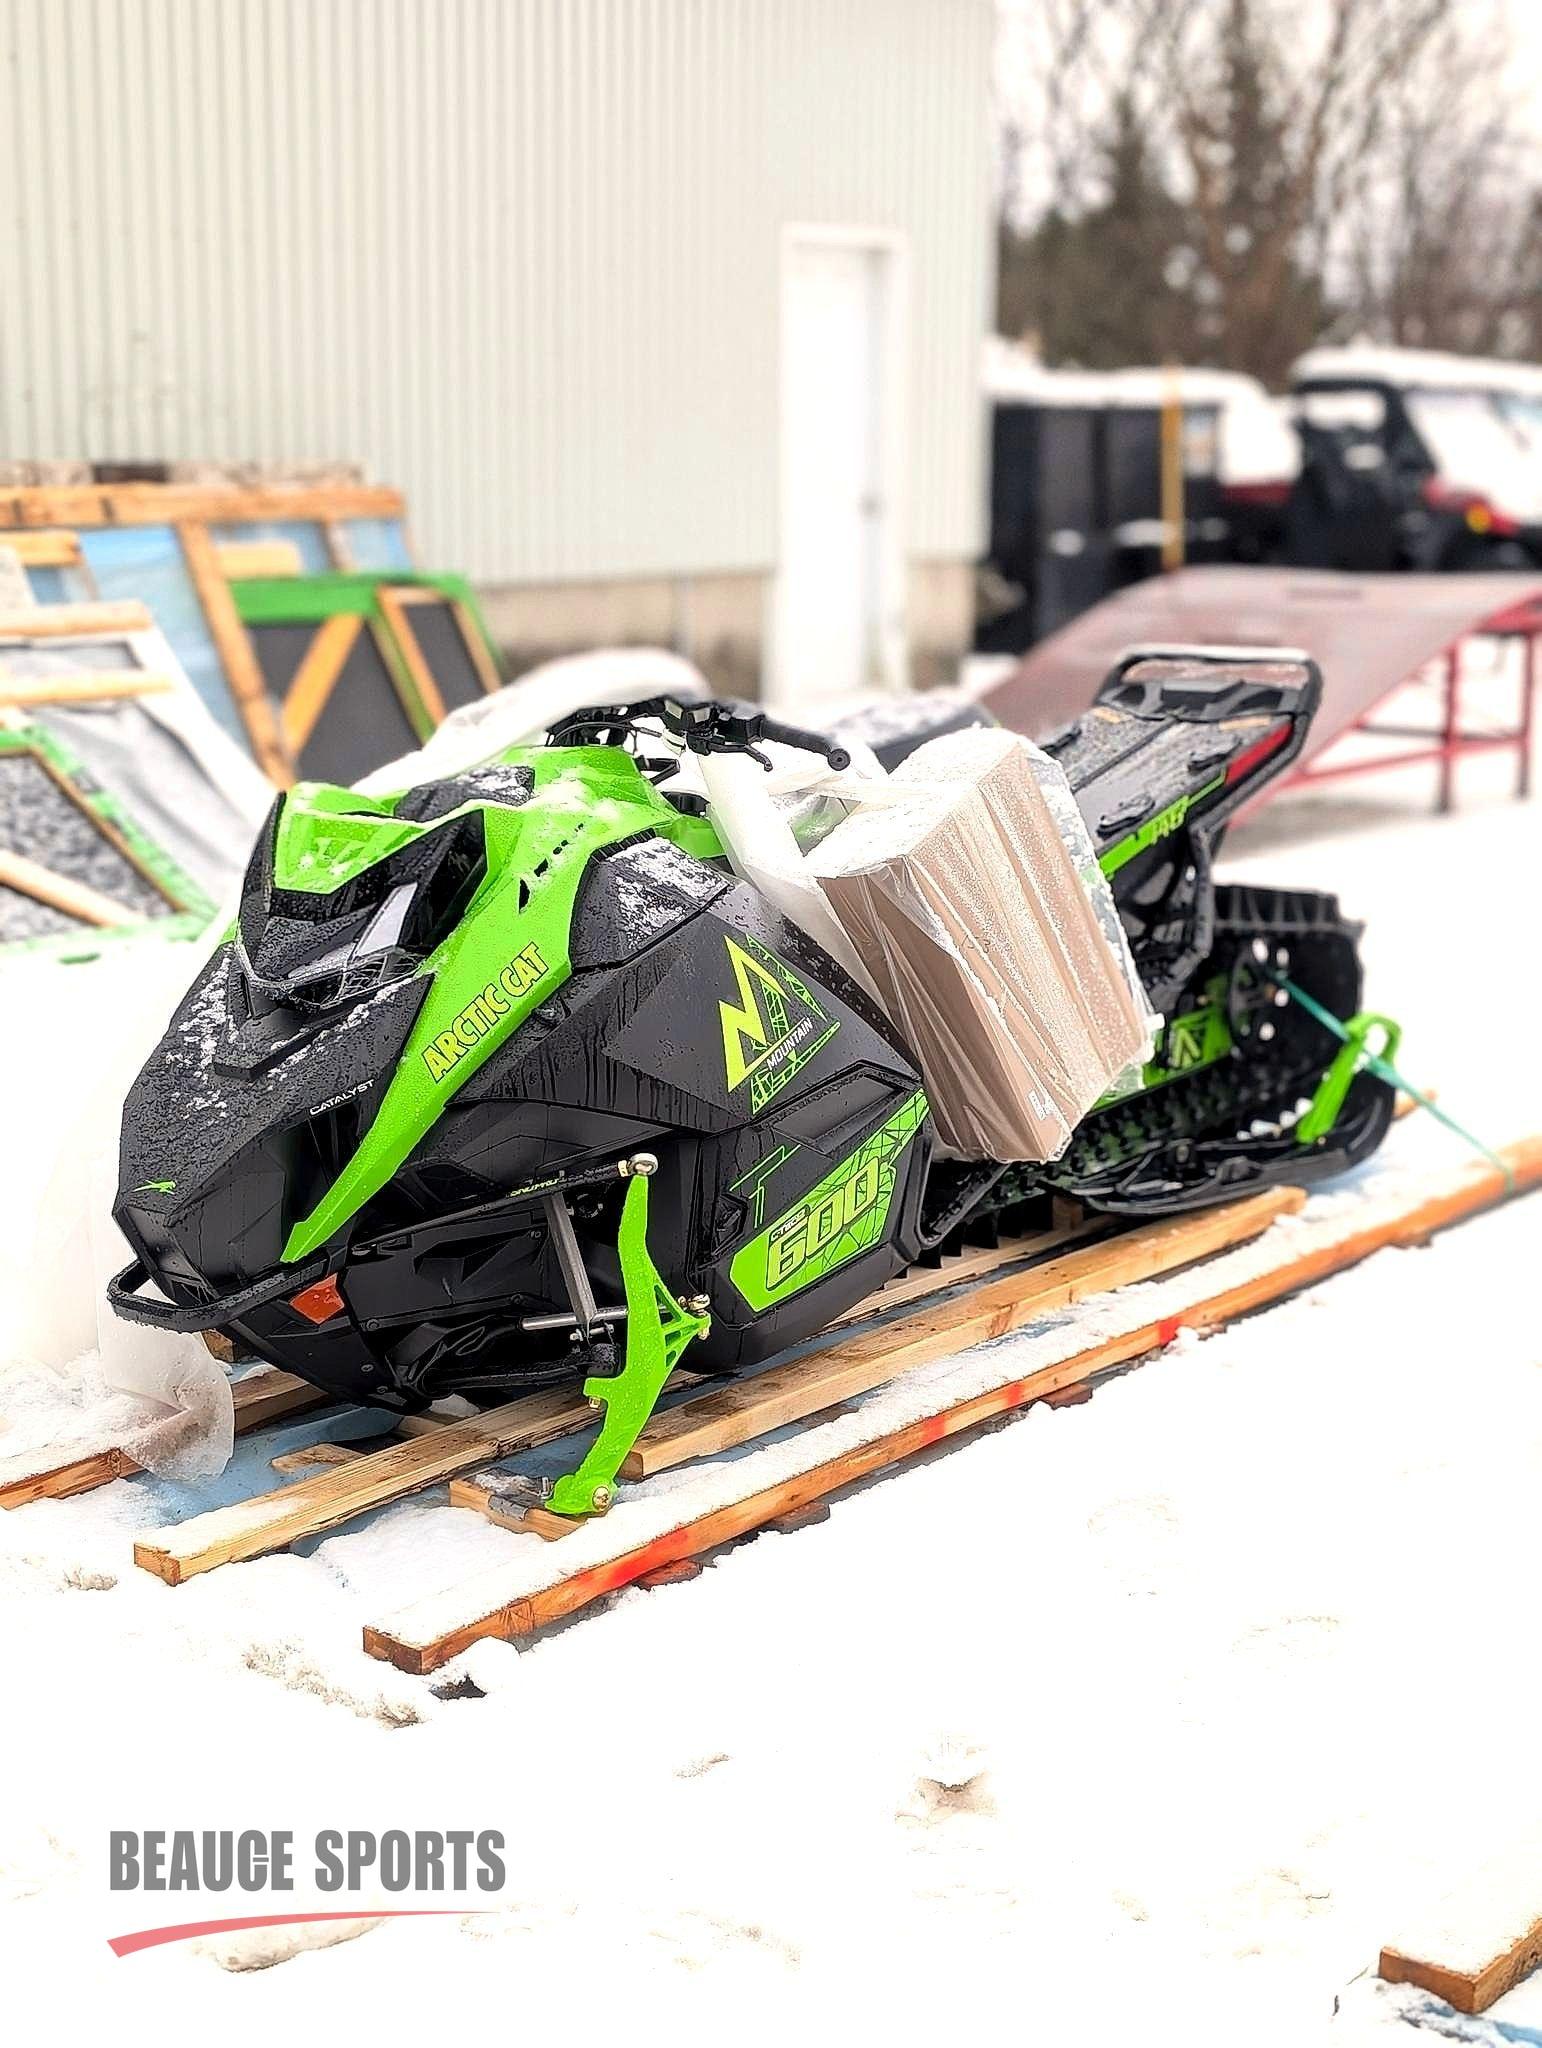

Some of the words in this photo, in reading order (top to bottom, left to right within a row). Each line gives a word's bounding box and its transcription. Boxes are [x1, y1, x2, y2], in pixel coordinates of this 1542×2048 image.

[421, 982, 512, 1084] ARCTIC
[499, 941, 550, 998] CAT
[765, 1016, 815, 1071] MOUNTAIN
[309, 1079, 375, 1116] CATALYST
[766, 1155, 880, 1291] 600
